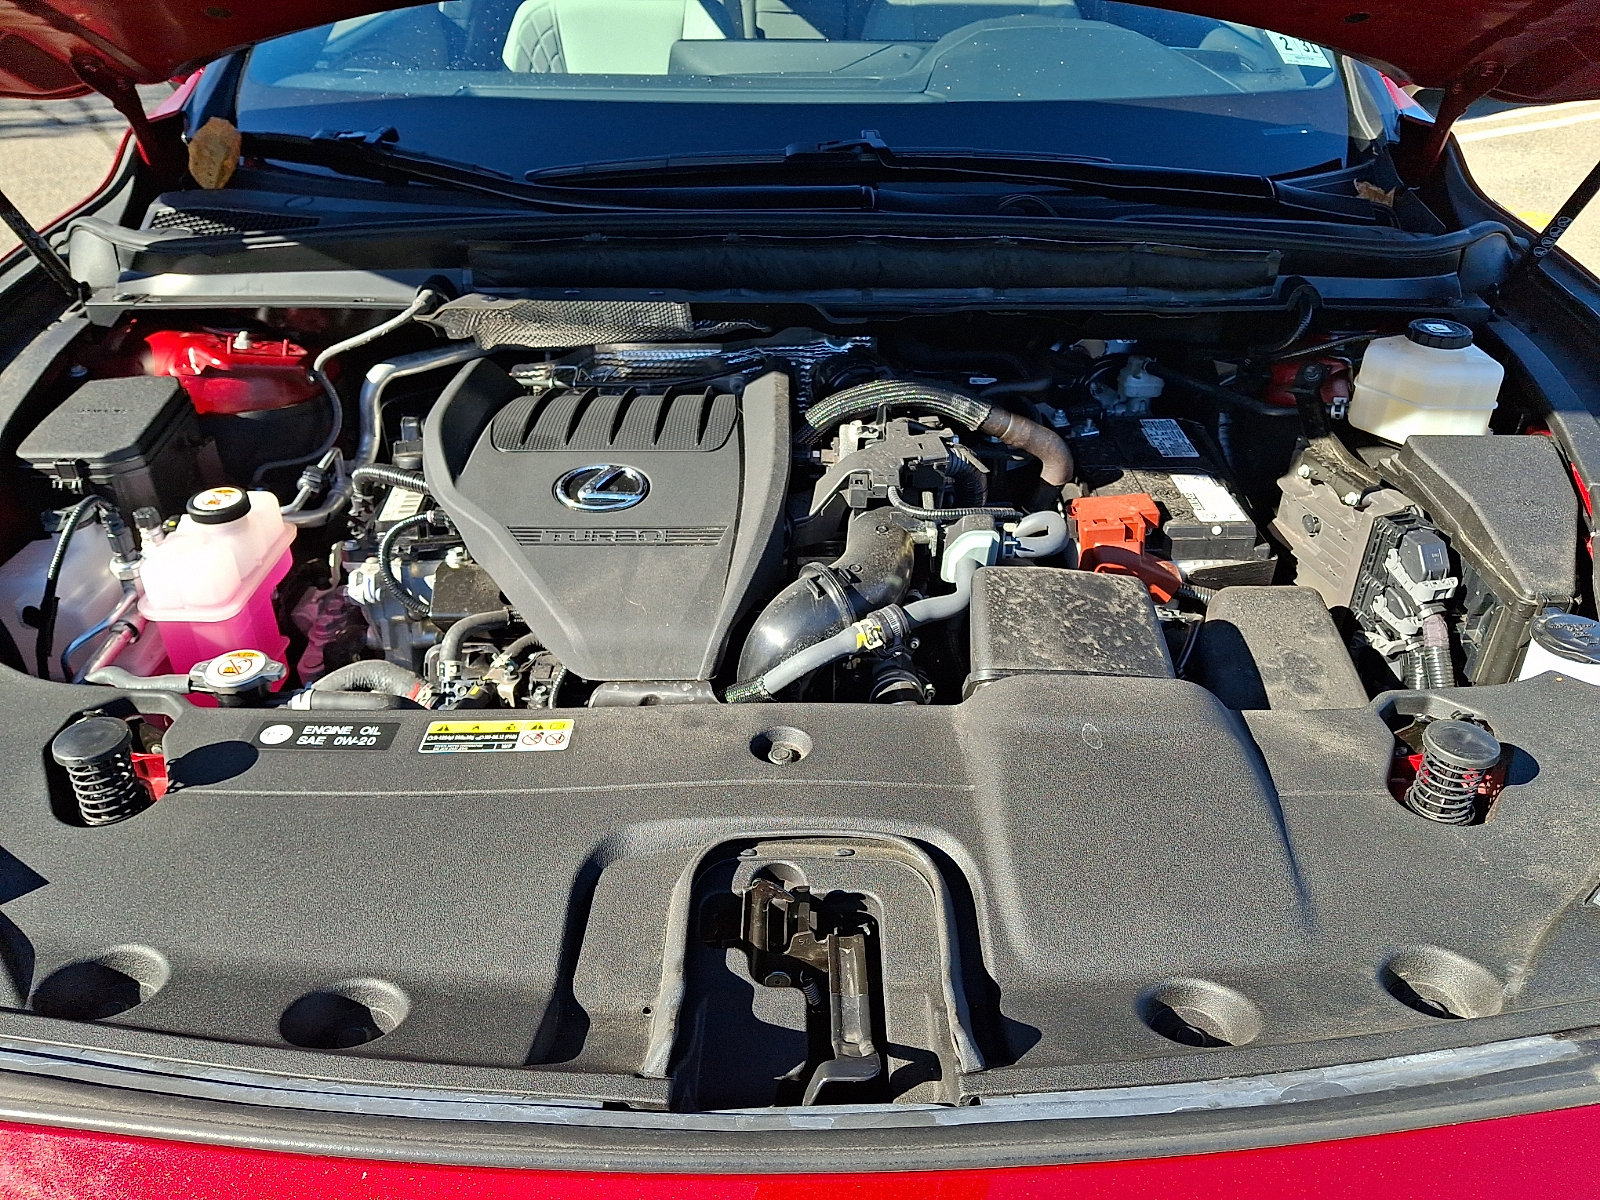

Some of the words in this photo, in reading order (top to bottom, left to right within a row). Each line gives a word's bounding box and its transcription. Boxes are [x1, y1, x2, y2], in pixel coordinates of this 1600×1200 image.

[1279, 36, 1293, 51] 2
[545, 529, 665, 543] TURBO
[302, 725, 354, 735] ENGINE
[359, 726, 382, 736] OIL
[296, 736, 327, 746] SAE
[333, 736, 377, 746] 0W-20
